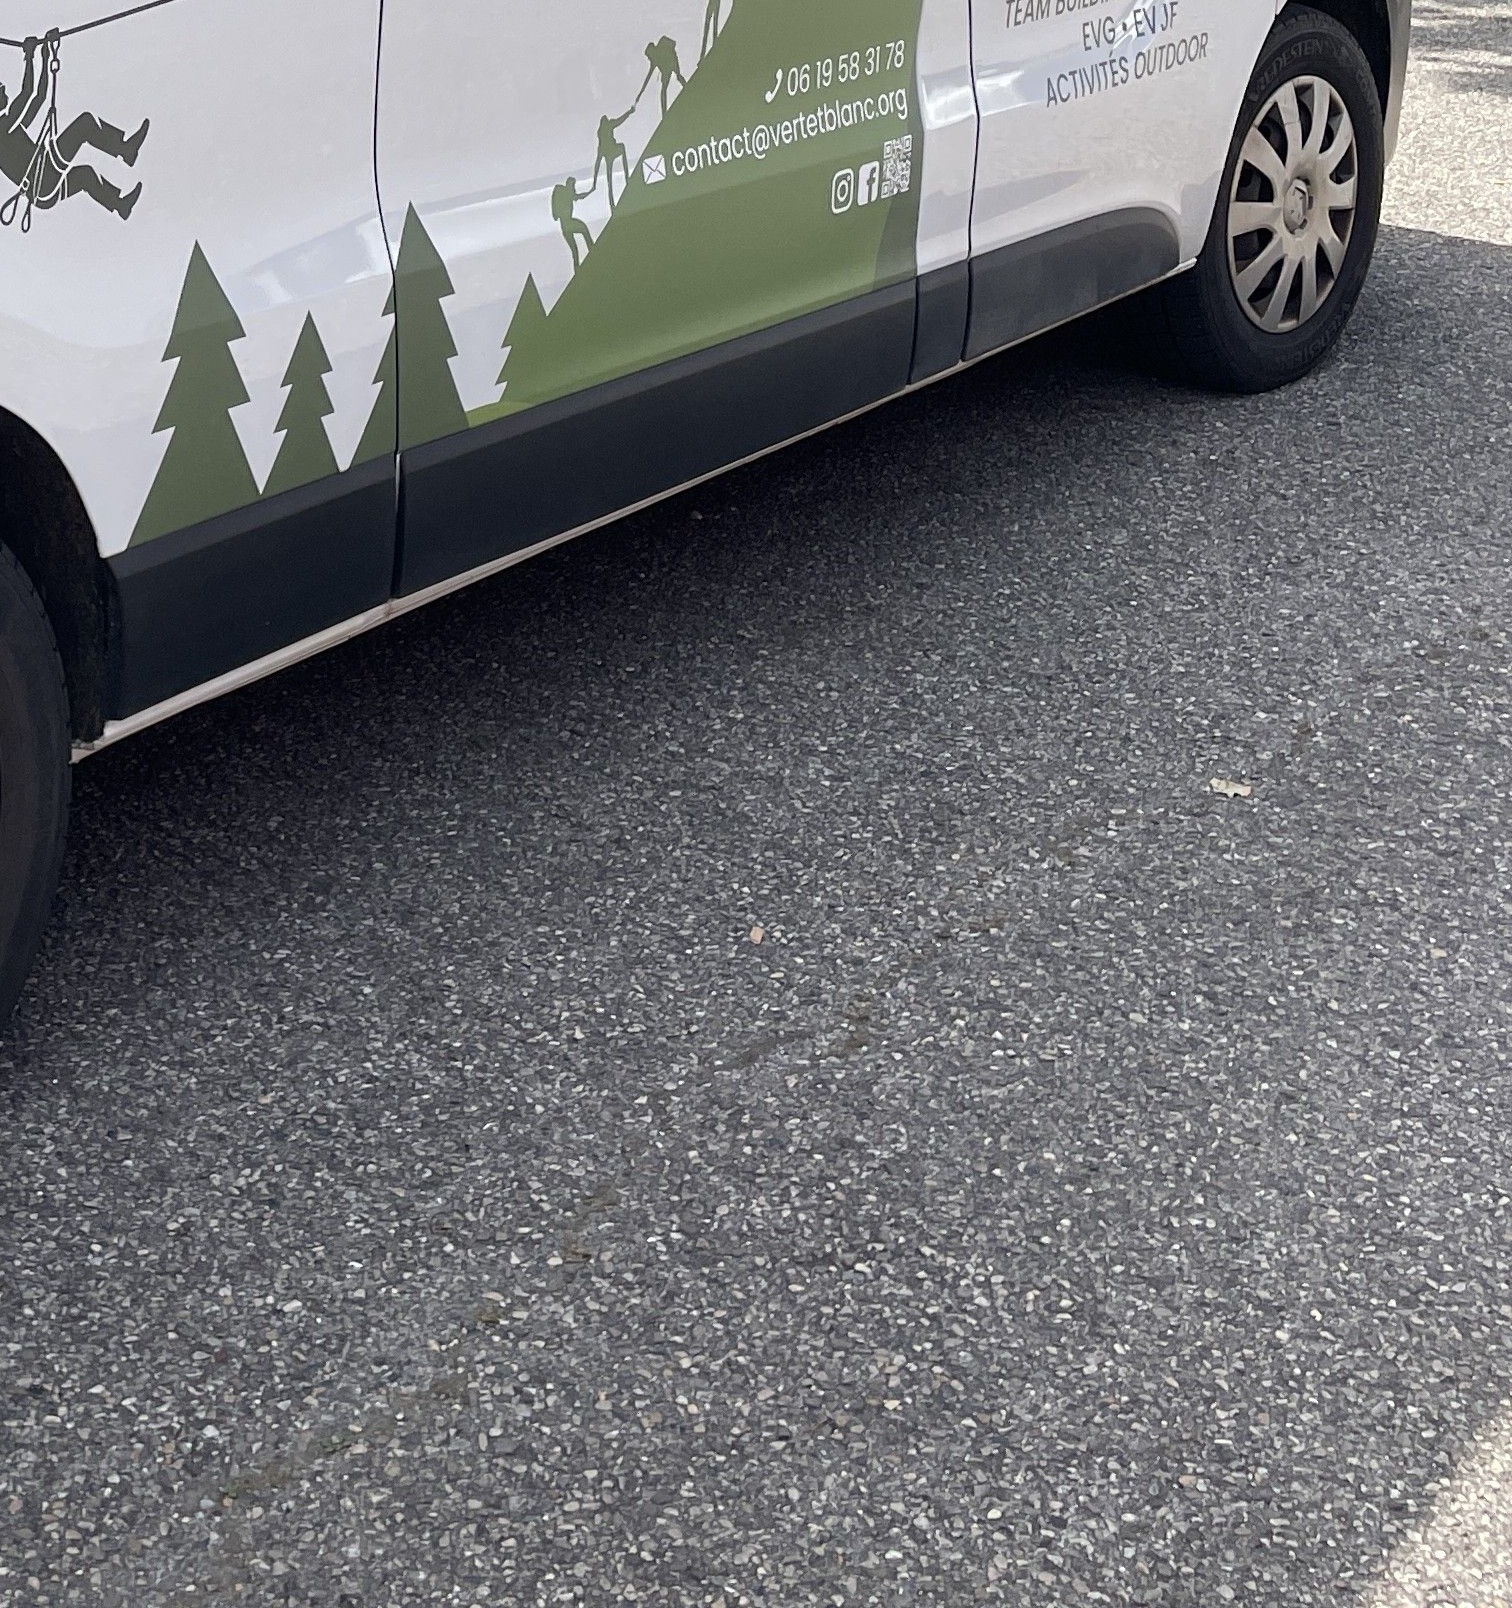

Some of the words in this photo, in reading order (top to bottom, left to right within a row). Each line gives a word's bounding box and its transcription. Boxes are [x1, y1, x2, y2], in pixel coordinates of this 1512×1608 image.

[1082, 15, 1116, 52] EVG
[787, 64, 810, 96] 06
[816, 58, 833, 89] 19
[838, 51, 860, 83] 58
[864, 46, 881, 76] 31
[885, 40, 905, 70] 78
[1046, 48, 1129, 108] ACTIVITÉS
[1134, 32, 1209, 80] OUTDOOR
[671, 88, 908, 176] contact@vertetblanc.org
